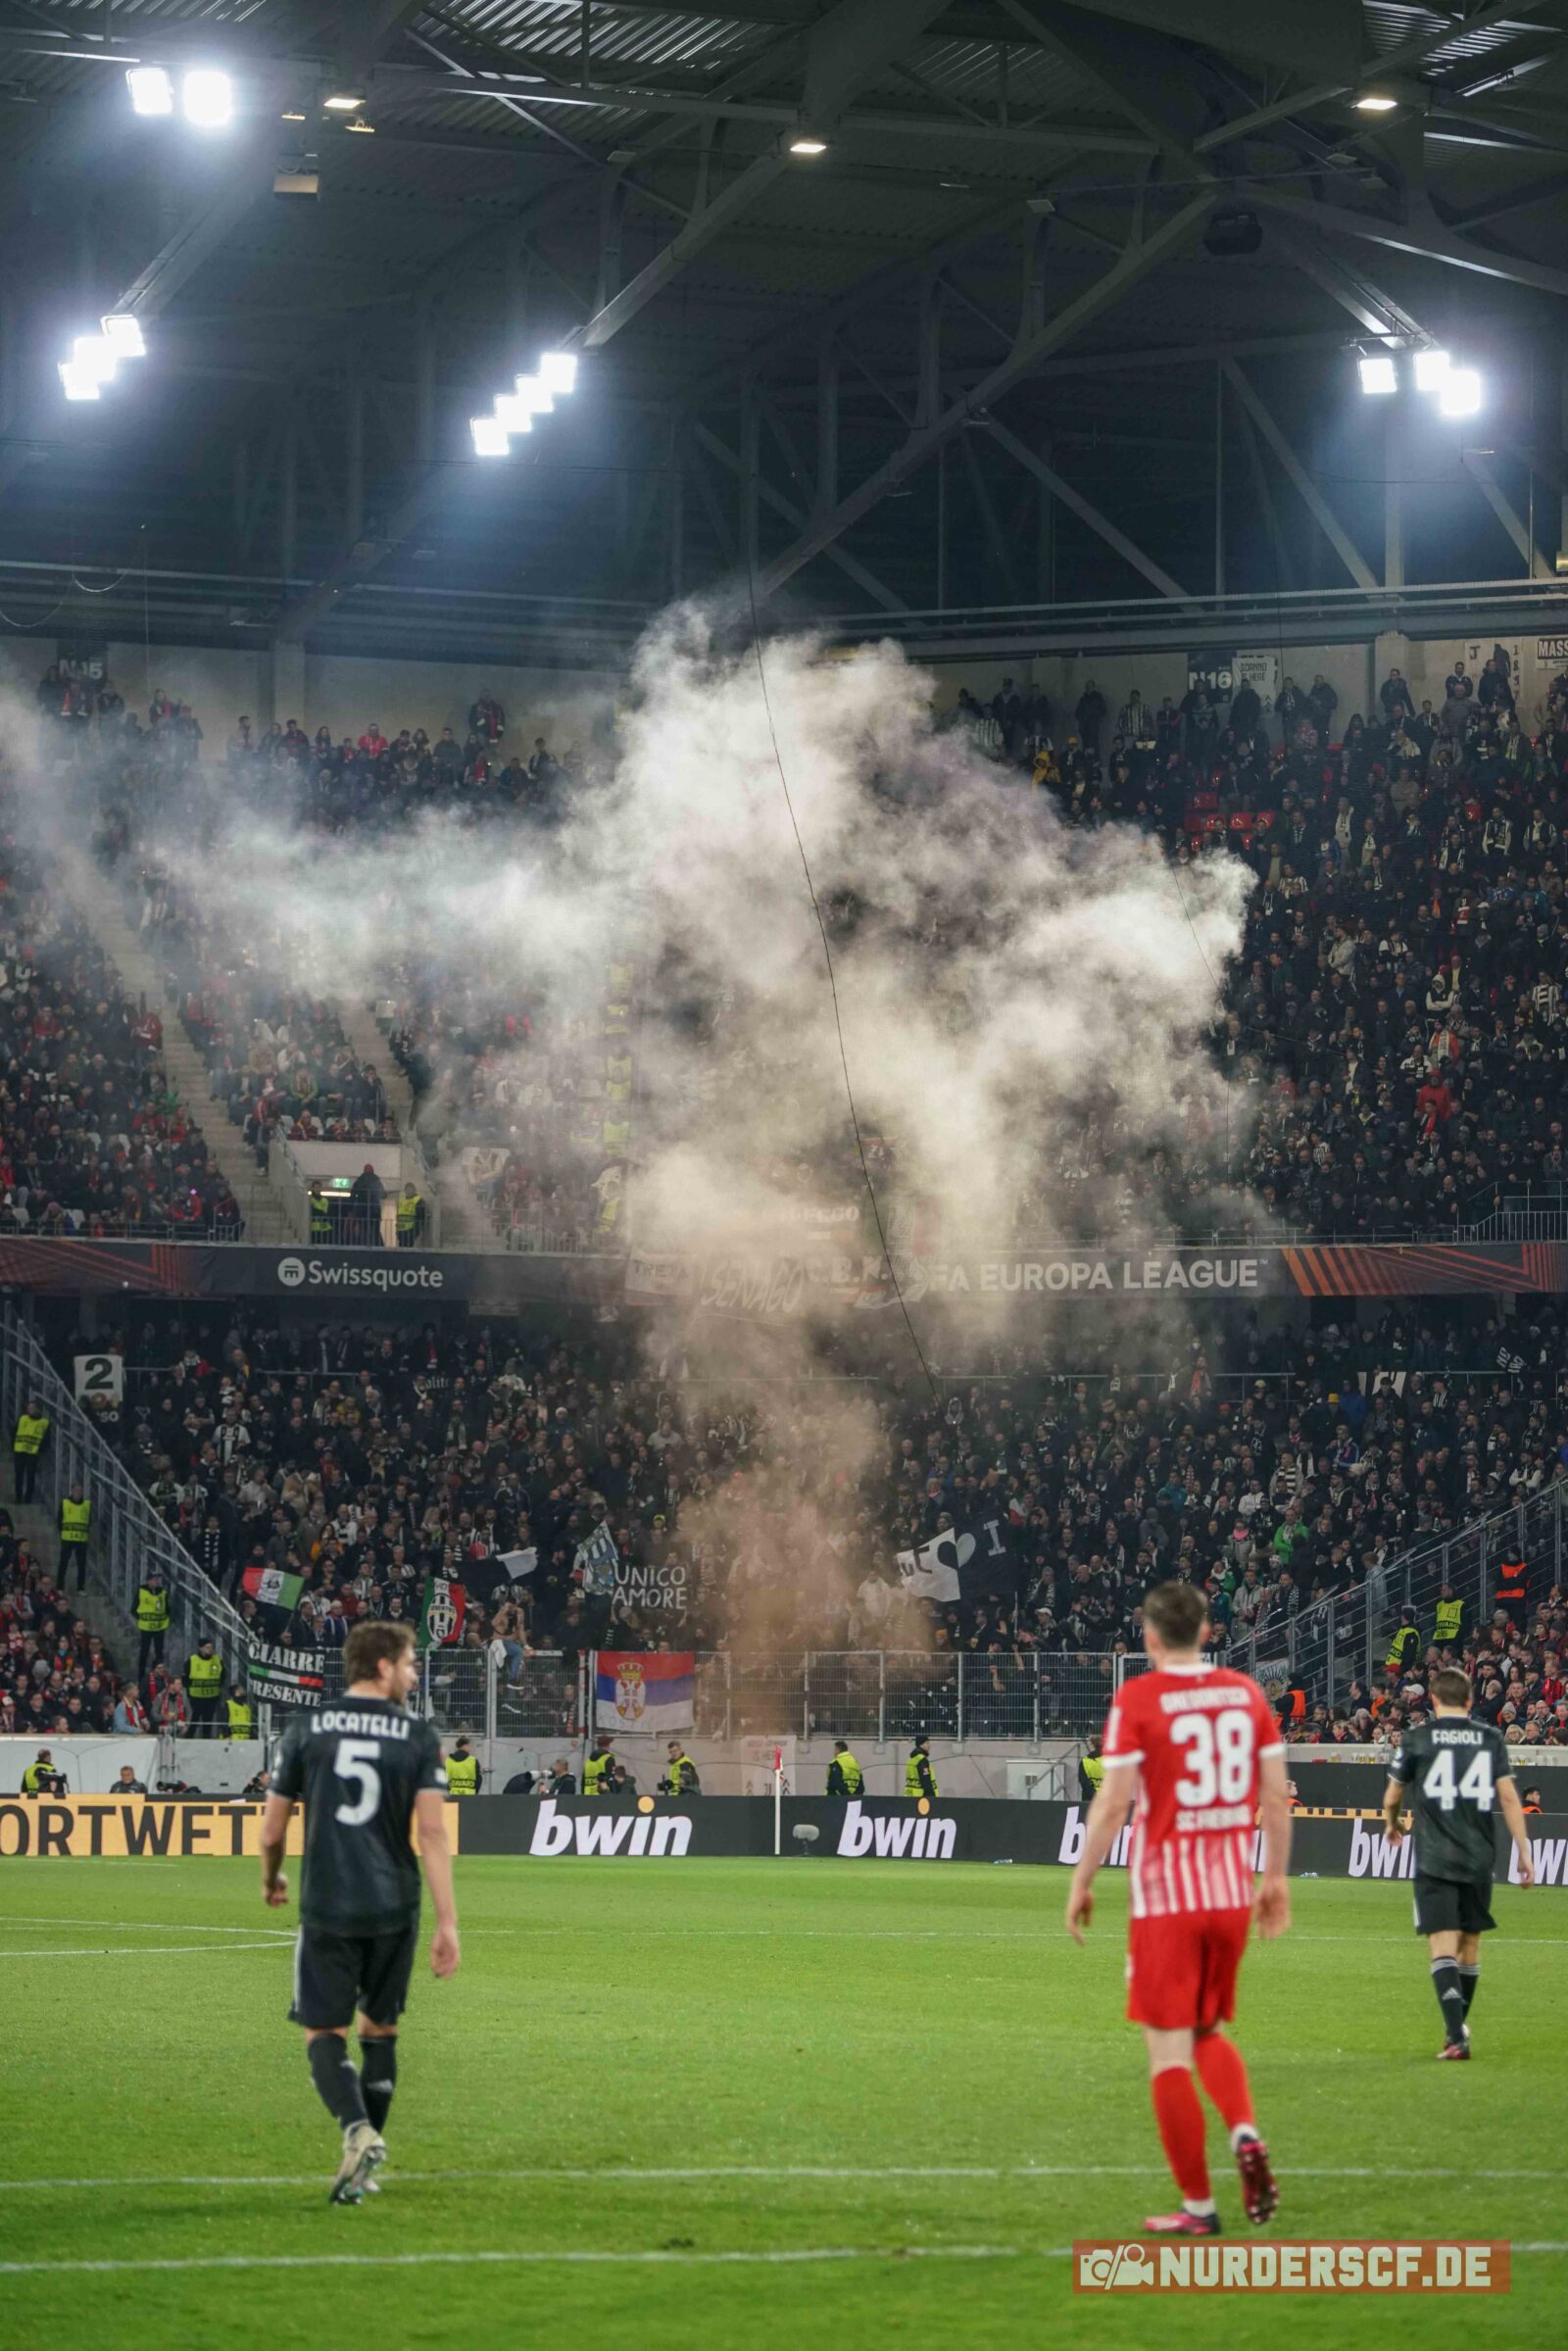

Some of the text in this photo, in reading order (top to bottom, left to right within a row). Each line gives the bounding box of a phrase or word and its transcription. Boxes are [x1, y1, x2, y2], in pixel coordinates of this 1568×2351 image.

[308, 1260, 444, 1292] Swissquote
[980, 1261, 1114, 1292] EUROPA
[1123, 1258, 1258, 1289] LEAGUE
[84, 1357, 114, 1390] 2
[613, 1565, 686, 1587] UNICO
[612, 1586, 688, 1609] AMORE
[248, 1639, 325, 1675] GIARRE
[311, 1710, 410, 1740] LOCATELLI
[1432, 1729, 1484, 1745] FAGIOLI
[1170, 1709, 1253, 1807] 38
[333, 1738, 382, 1826] 5
[1423, 1749, 1495, 1811] 44
[528, 1795, 693, 1856] bwin
[836, 1796, 957, 1858] bwin
